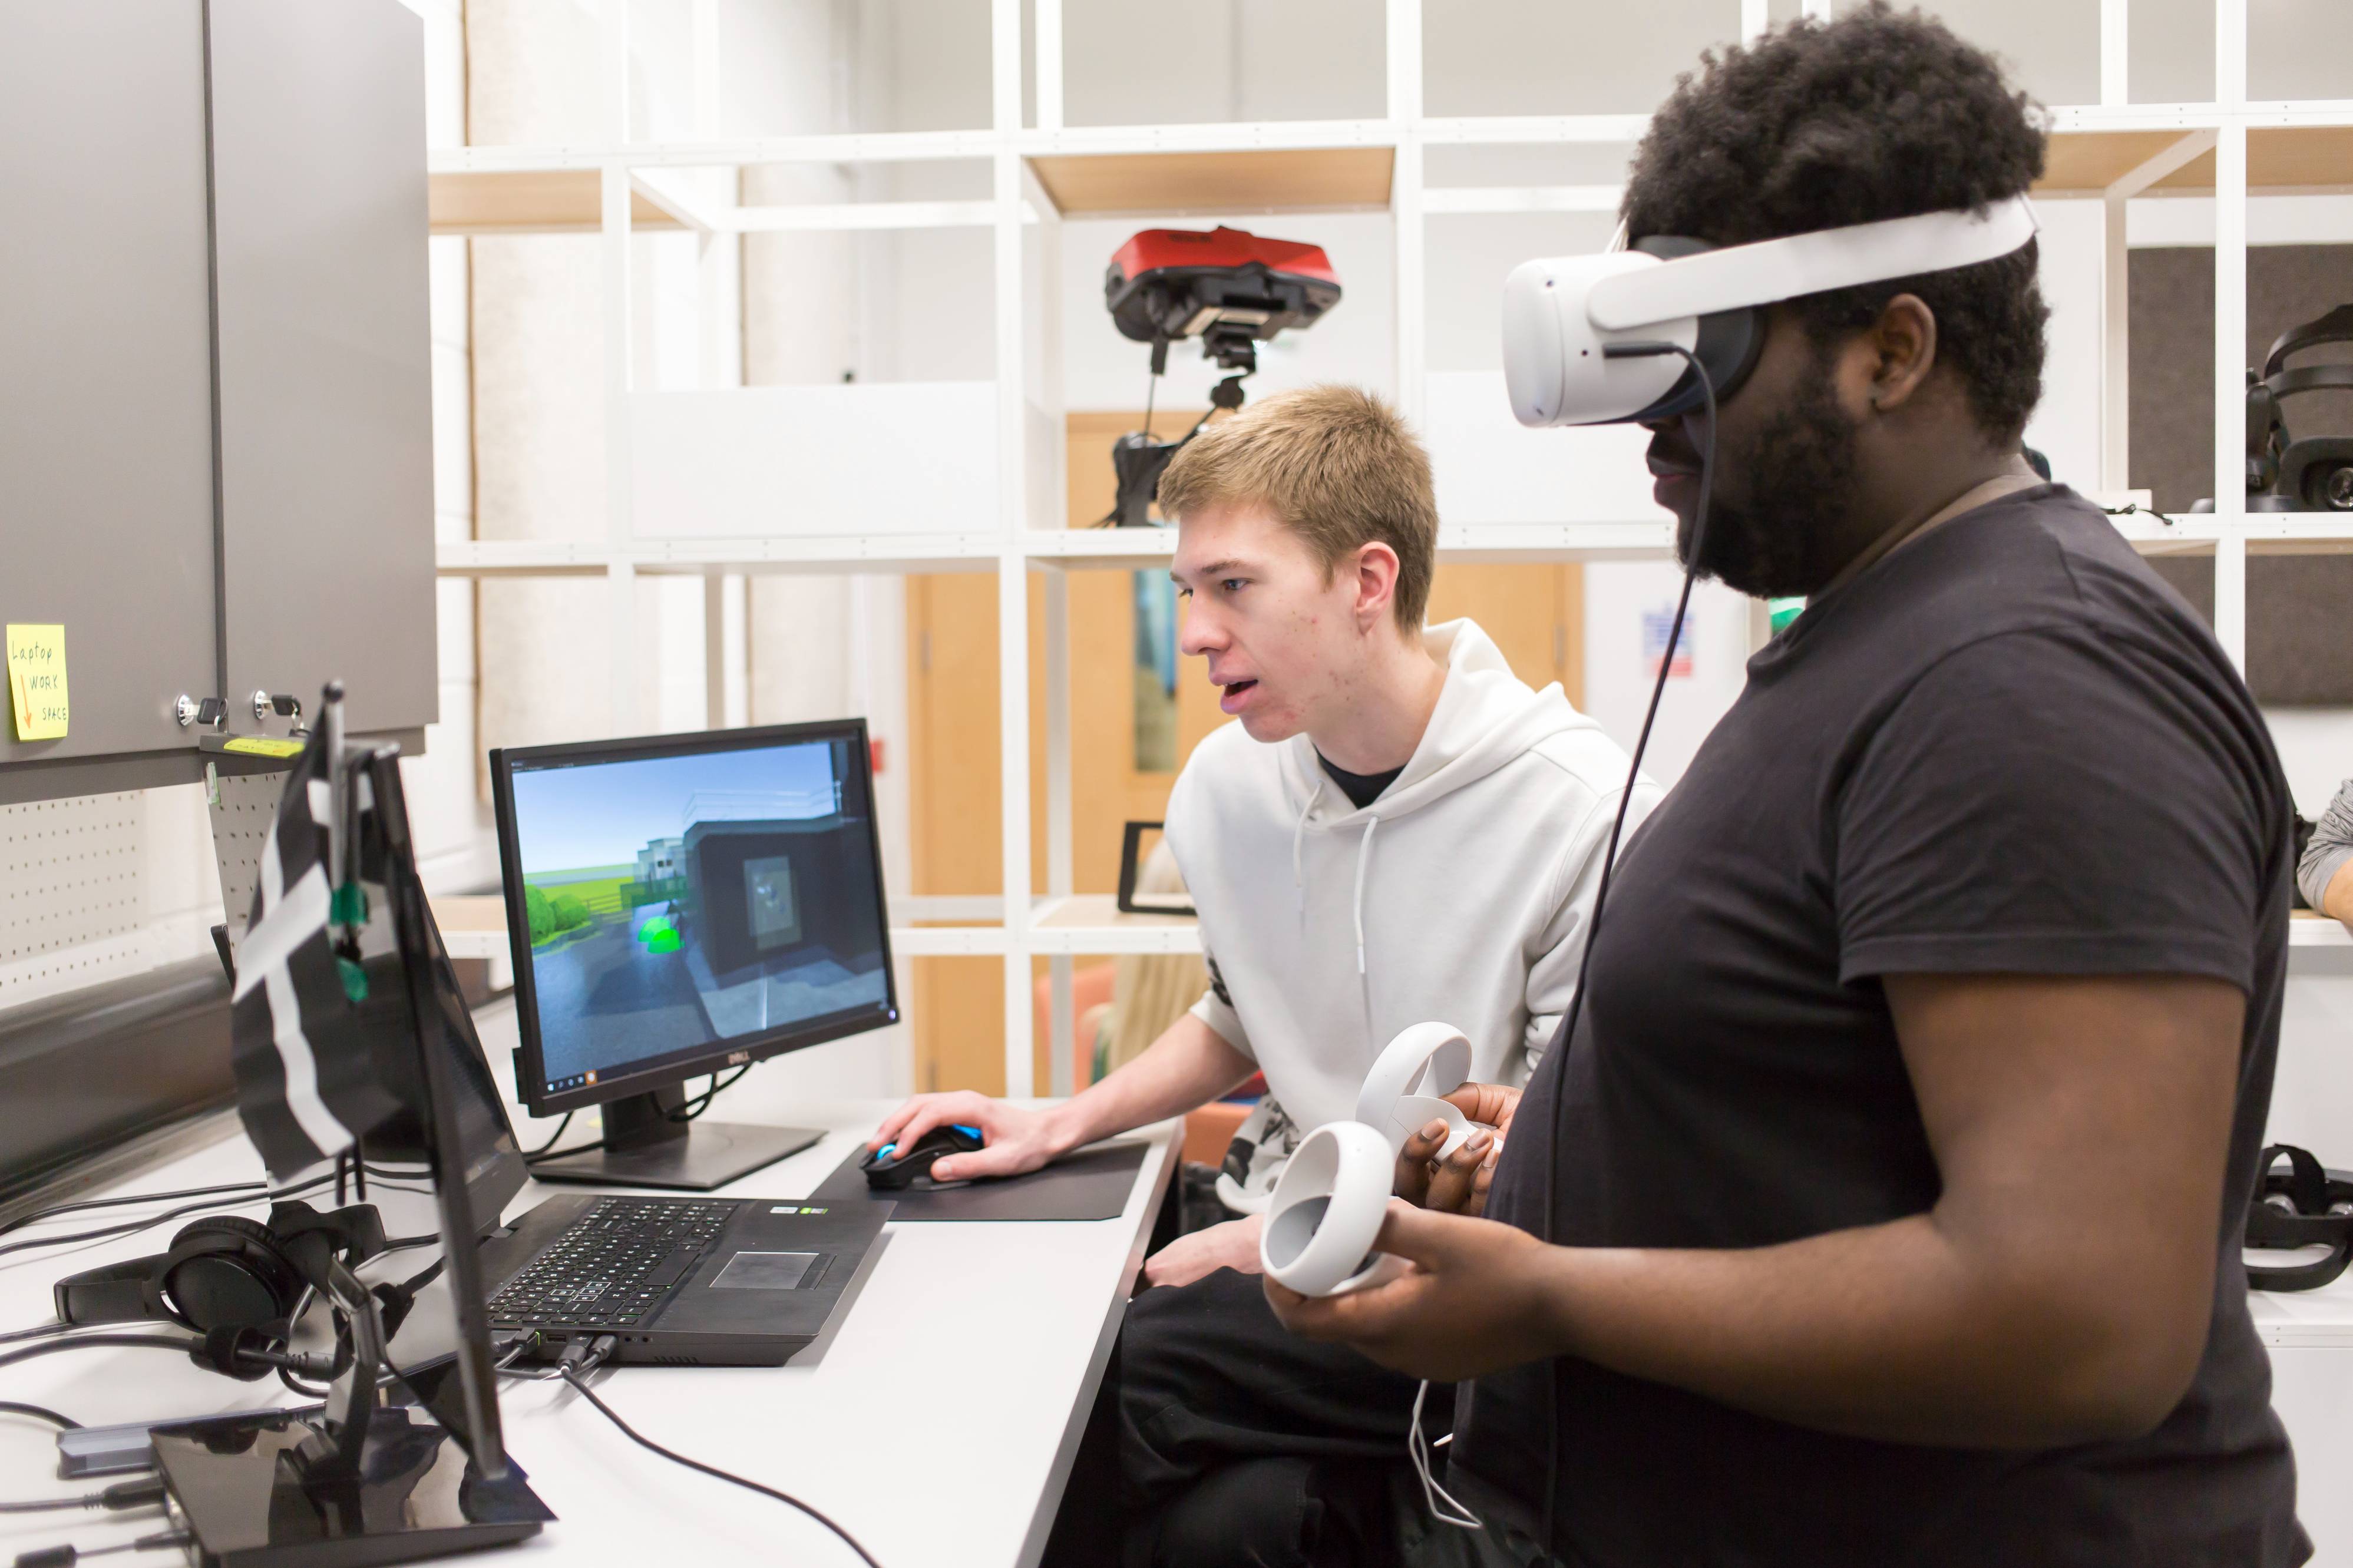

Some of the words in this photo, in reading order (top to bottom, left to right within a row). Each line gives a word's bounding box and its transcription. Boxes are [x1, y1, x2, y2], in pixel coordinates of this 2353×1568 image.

[12, 640, 52, 664] Laptop
[29, 674, 58, 690] WORK
[42, 707, 67, 720] SPACE
